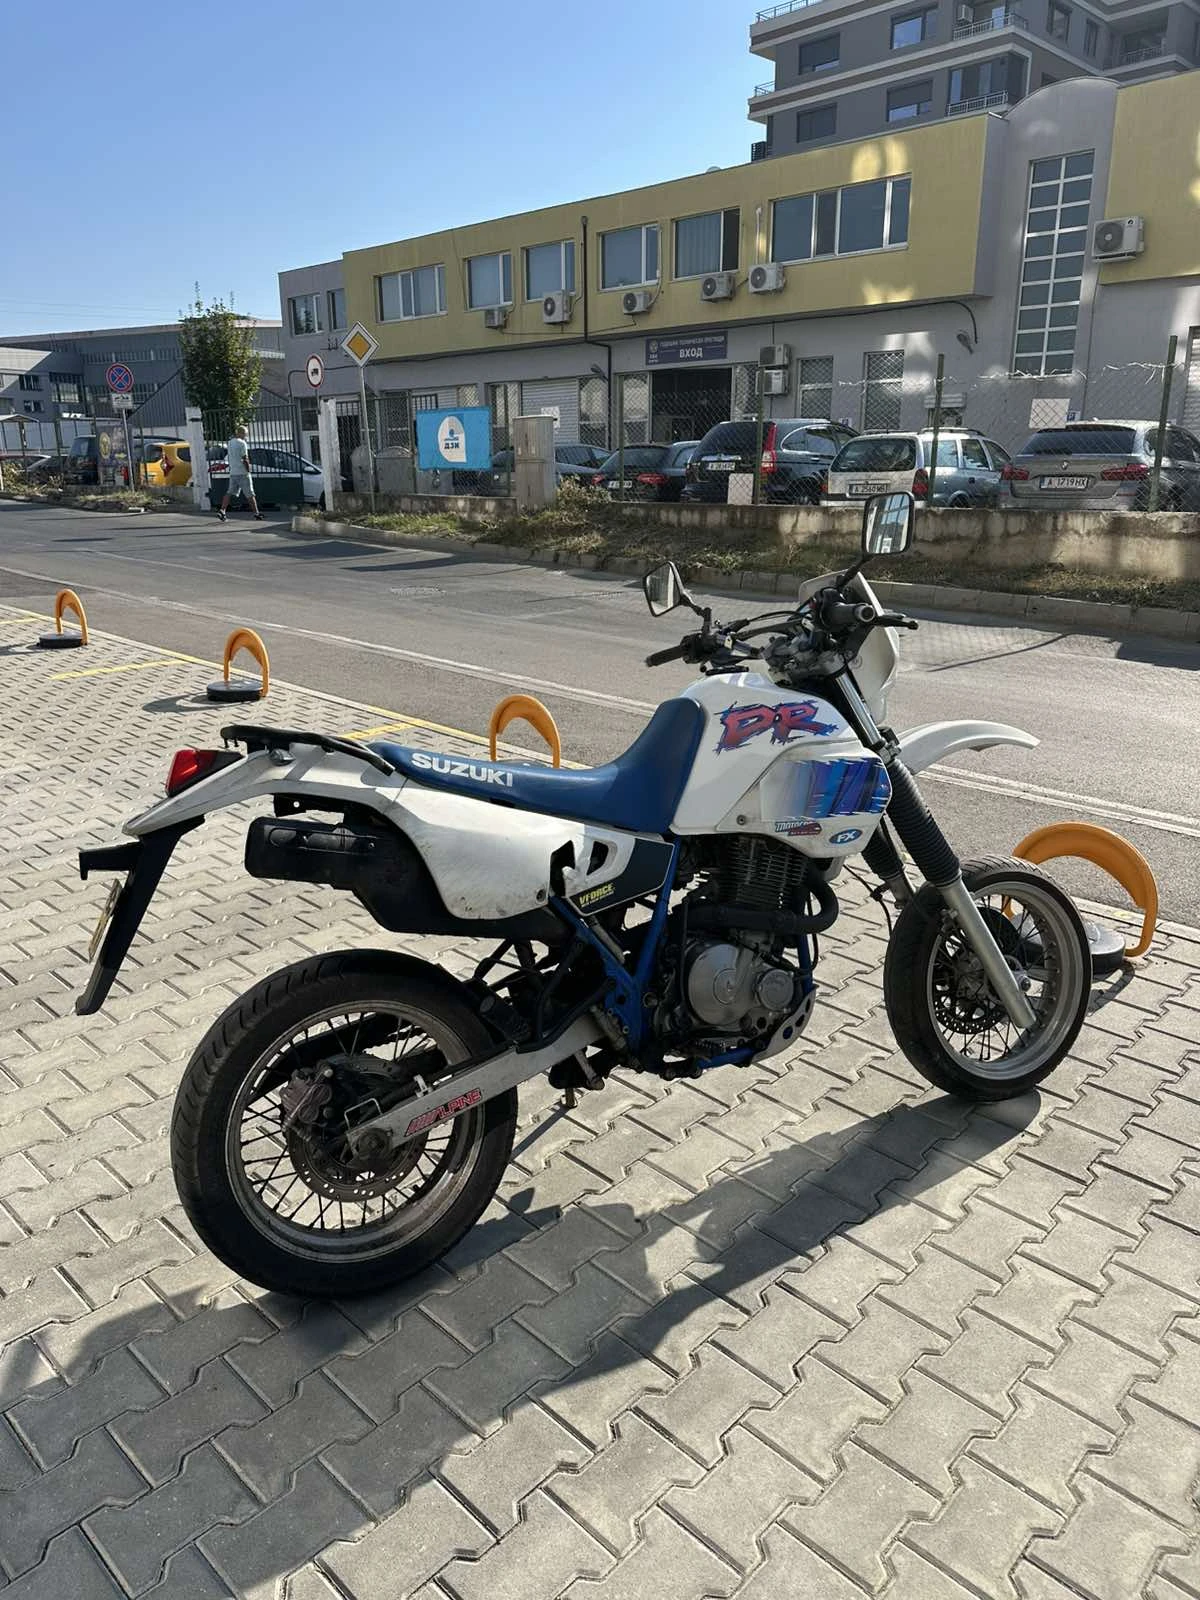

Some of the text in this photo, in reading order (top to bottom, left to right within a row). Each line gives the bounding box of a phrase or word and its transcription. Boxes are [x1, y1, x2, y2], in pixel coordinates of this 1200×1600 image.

[679, 347, 703, 358] ВХОД
[713, 701, 839, 755] DR
[411, 752, 513, 787] SUZUKI
[836, 830, 857, 843] FX
[409, 1088, 482, 1133] ALPINE
